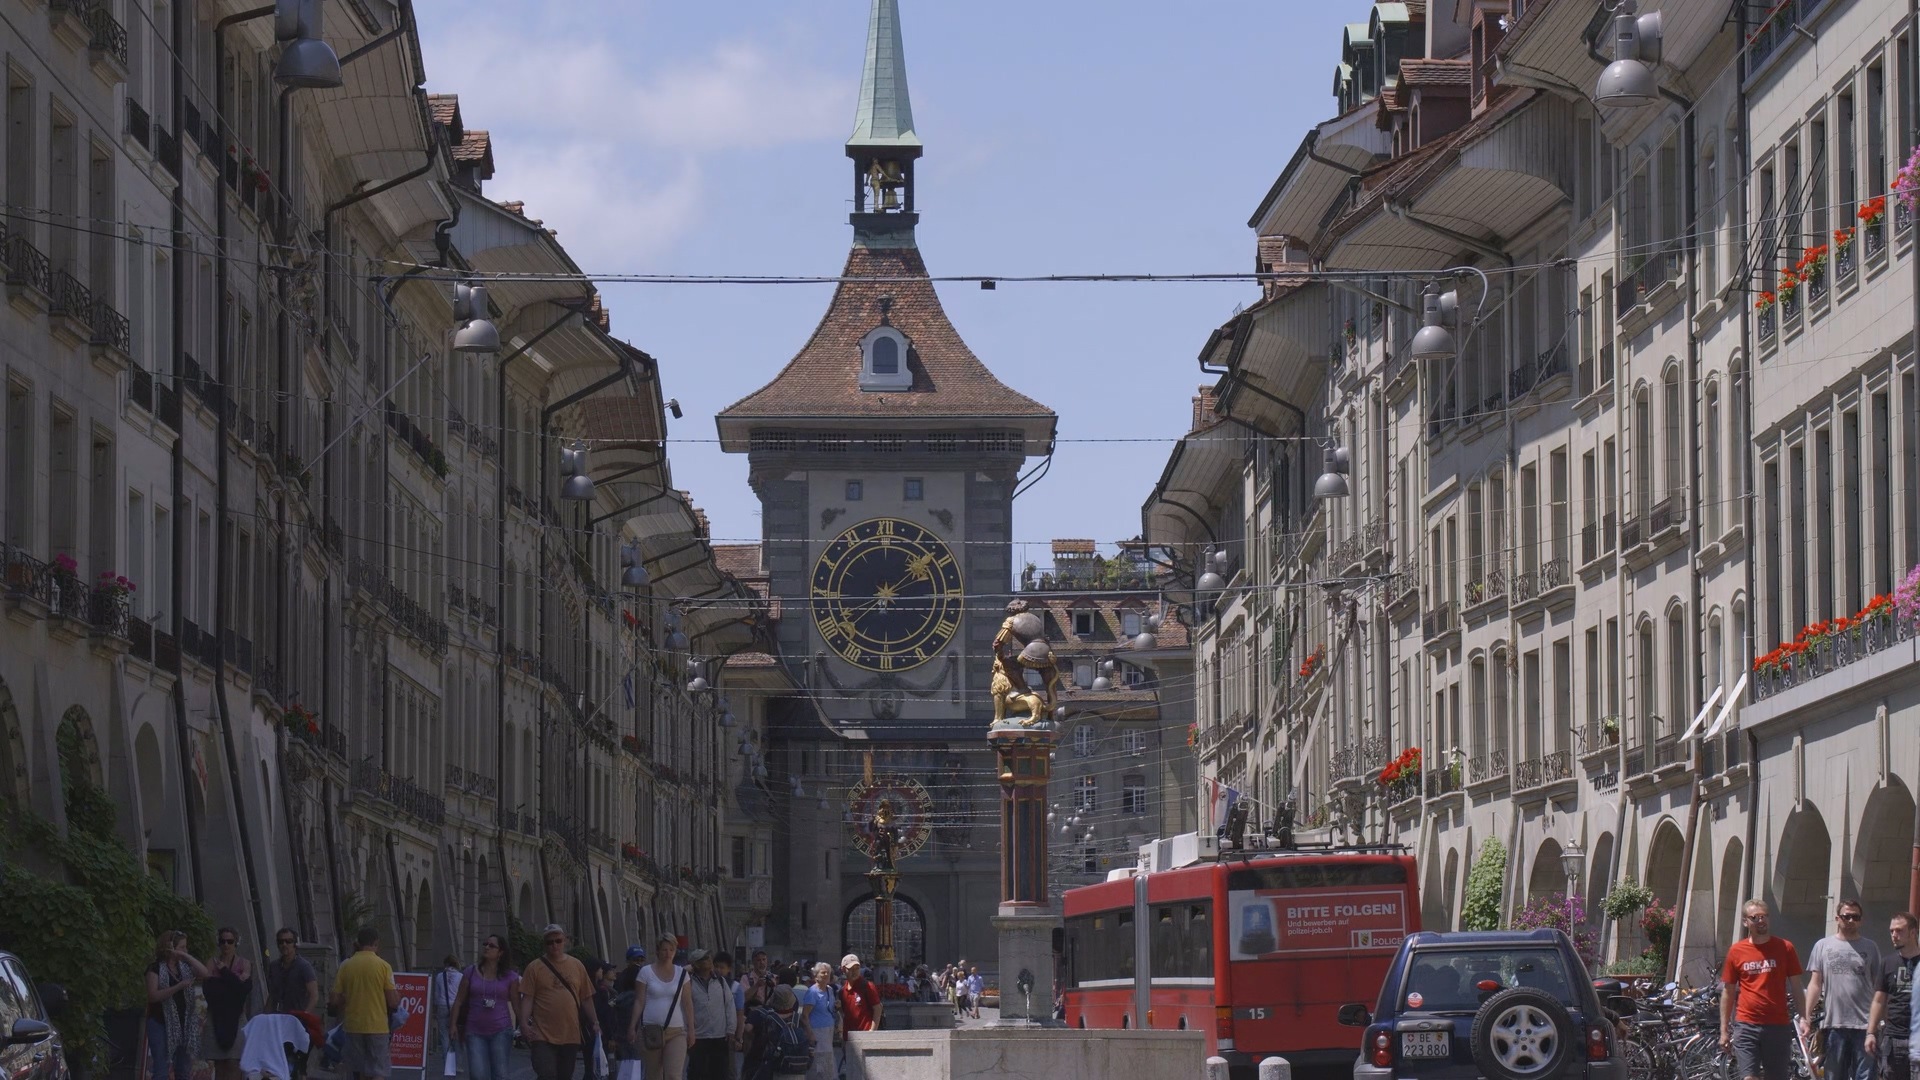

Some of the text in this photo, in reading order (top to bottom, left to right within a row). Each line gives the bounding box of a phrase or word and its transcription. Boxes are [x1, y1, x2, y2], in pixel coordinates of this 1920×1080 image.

[876, 520, 894, 535] XII
[938, 554, 952, 568] II
[813, 586, 827, 598] X
[936, 619, 955, 638] IIII
[1287, 904, 1396, 918] BITTE FOLGEN!
[1288, 927, 1333, 936] polizei-job.ch
[1743, 959, 1776, 971] OSKAR
[1249, 1008, 1265, 1019] 15
[1420, 1034, 1431, 1042] BE
[1404, 1044, 1447, 1056] 223 880
